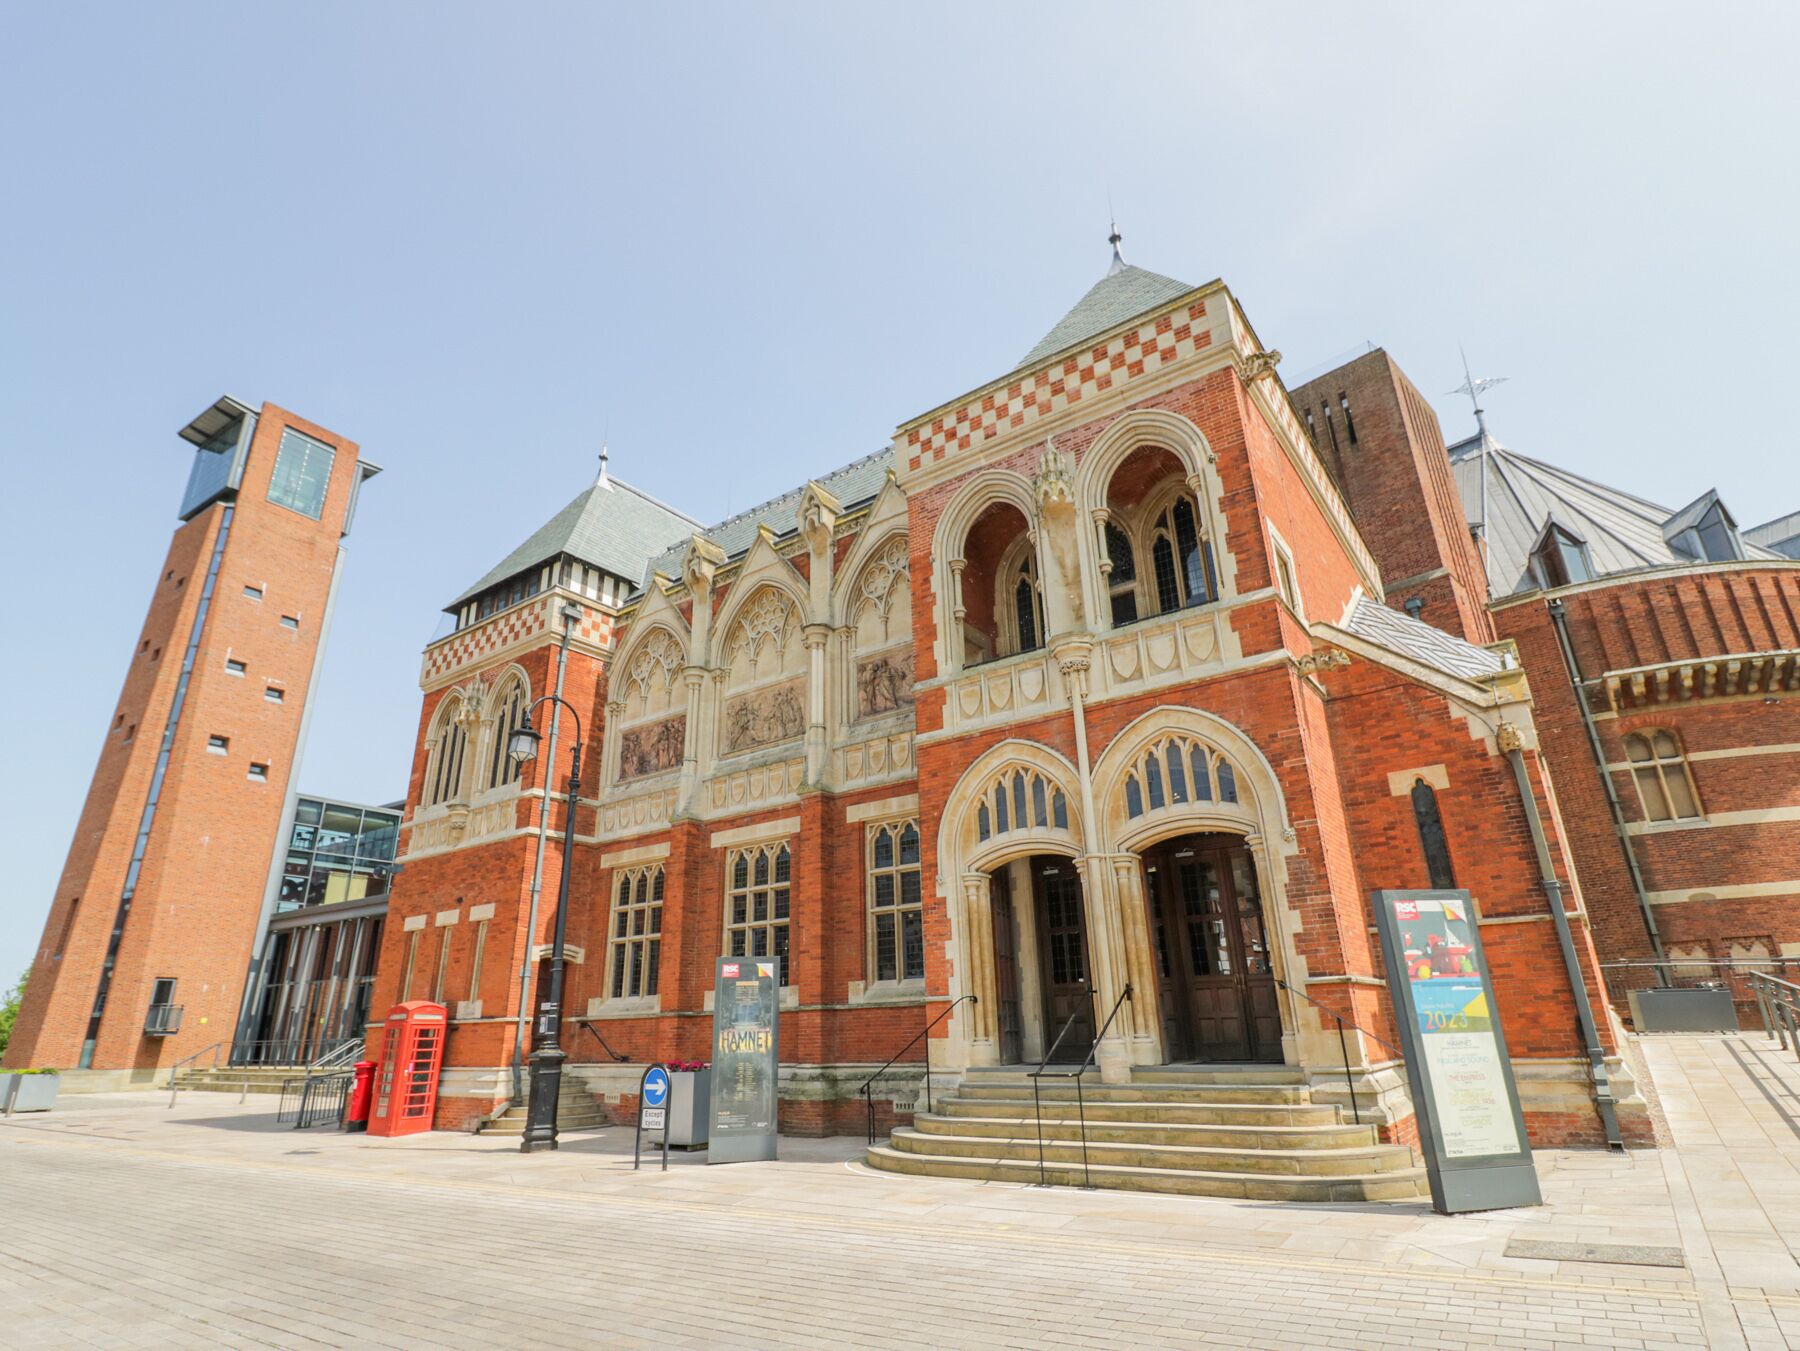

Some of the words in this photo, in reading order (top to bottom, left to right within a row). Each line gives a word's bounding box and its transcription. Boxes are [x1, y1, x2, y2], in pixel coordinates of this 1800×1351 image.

[1424, 1010, 1469, 1030] 2023
[721, 1030, 770, 1053] HAMNET
[644, 1110, 663, 1118] Except
